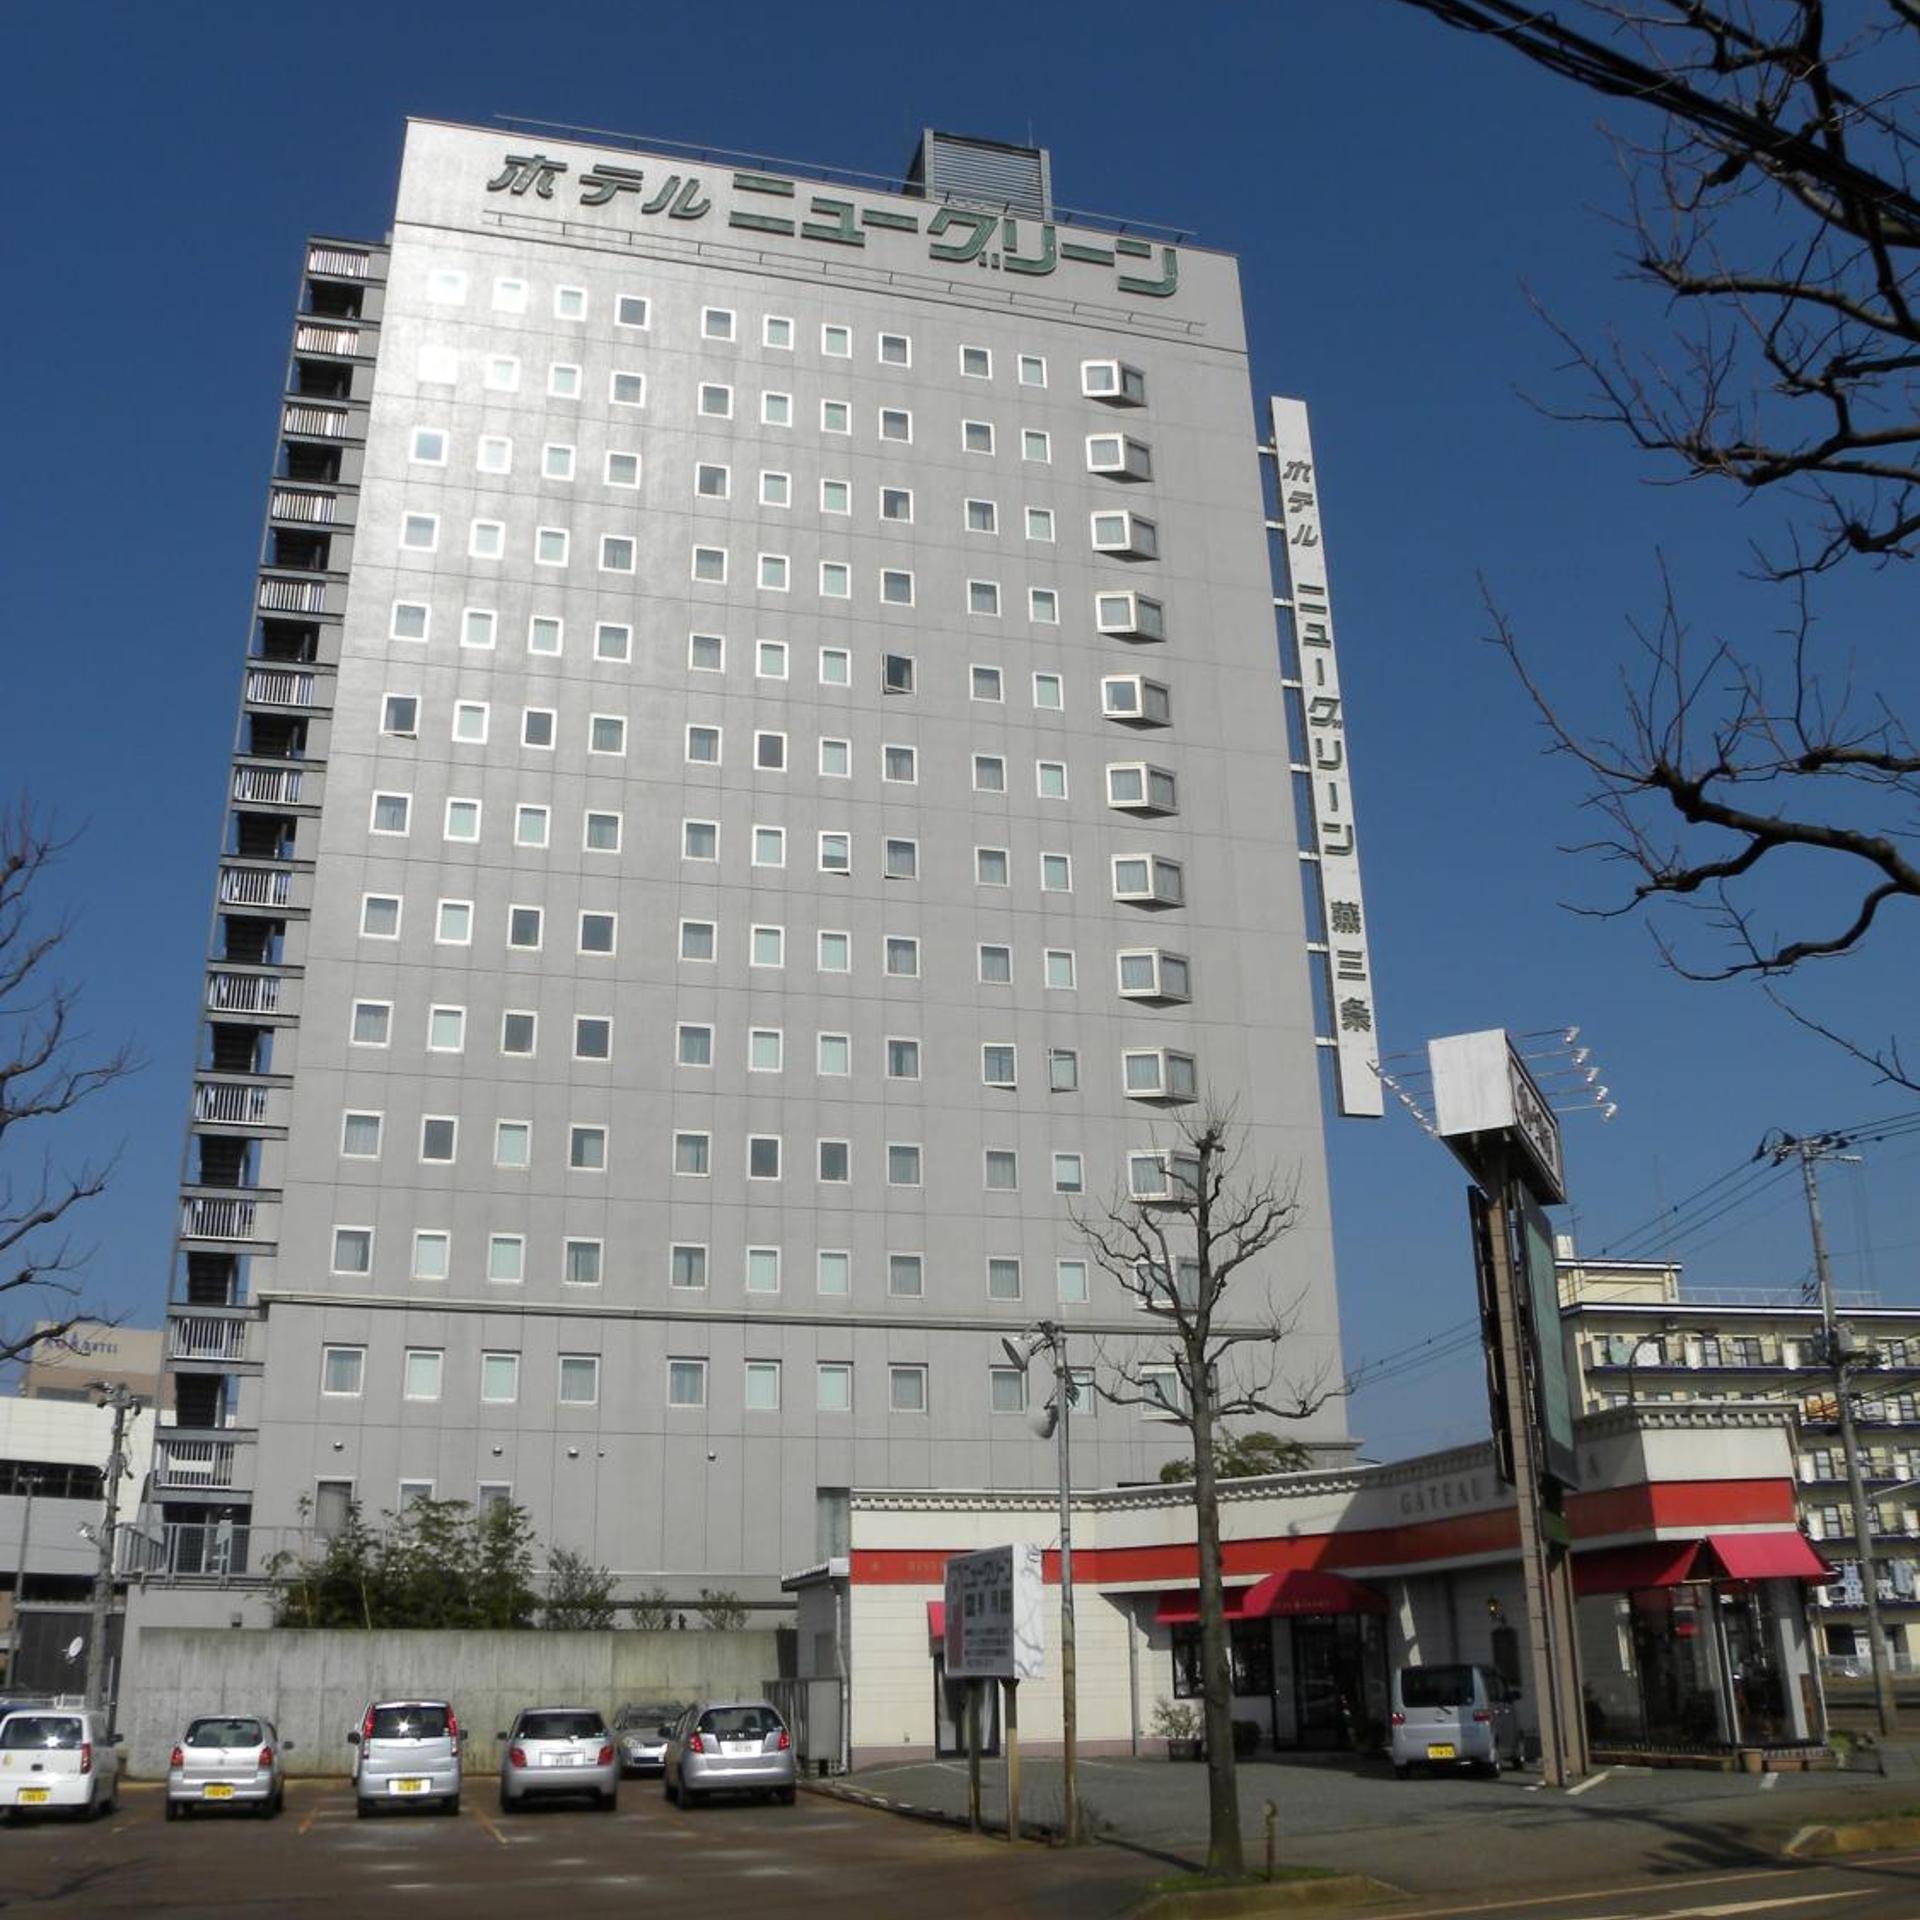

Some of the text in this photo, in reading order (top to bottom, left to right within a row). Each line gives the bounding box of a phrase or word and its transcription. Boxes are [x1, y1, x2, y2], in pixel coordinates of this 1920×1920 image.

[1282, 460, 1318, 547] ホテル
[1297, 583, 1353, 855] ニューグリーン
